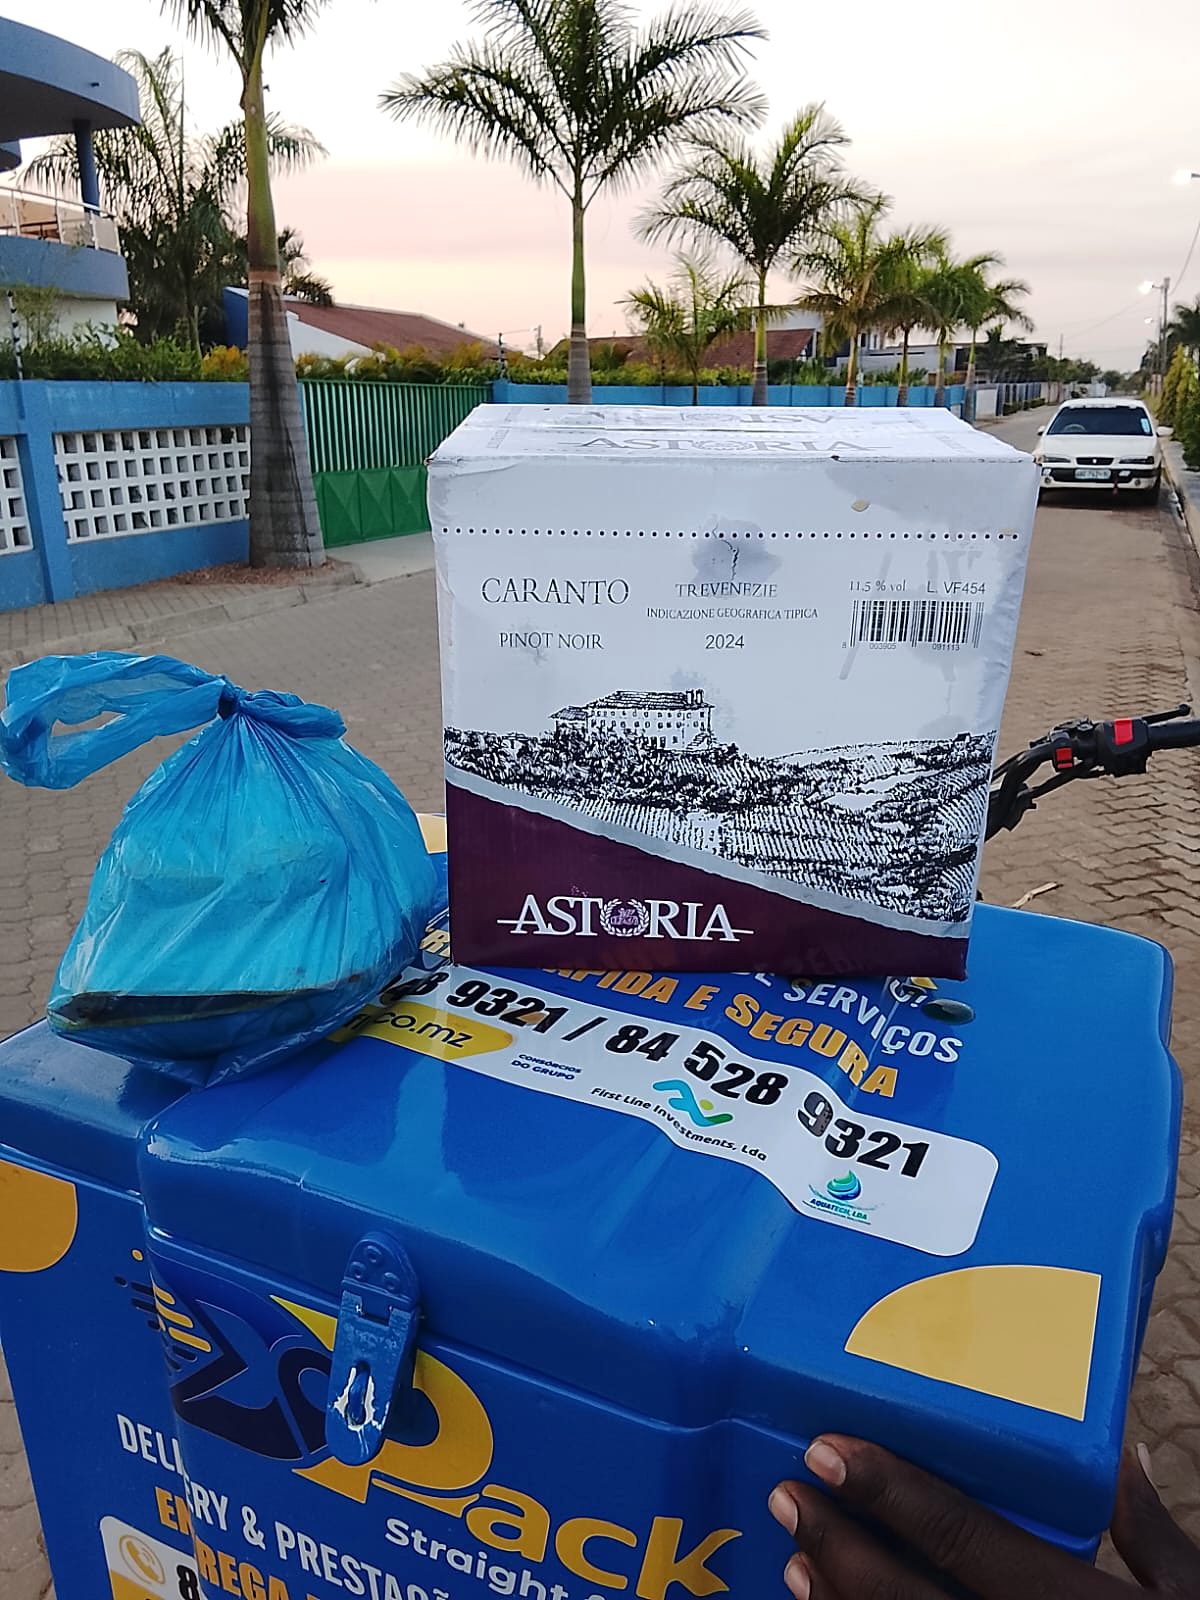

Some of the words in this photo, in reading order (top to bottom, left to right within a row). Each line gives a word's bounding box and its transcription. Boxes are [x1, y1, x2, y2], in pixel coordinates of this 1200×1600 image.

[559, 437, 893, 451] ASTORIA
[481, 577, 629, 605] CARANTO
[675, 582, 778, 598] TREVENEZIE
[891, 579, 906, 592] vol
[944, 581, 986, 594] VF454
[647, 607, 715, 620] INDICAZIONE
[717, 607, 781, 620] GEOGRAFICA
[784, 608, 818, 621] TIPICA
[499, 632, 553, 649] PINOT
[558, 633, 604, 650] NOIR
[705, 633, 745, 650] 2024
[497, 894, 754, 941] ASTORIA
[783, 978, 963, 1063] SERVIÇOS
[683, 985, 721, 1011] E
[724, 993, 899, 1098] SEGURA
[446, 980, 569, 1034] 9321
[605, 1024, 680, 1062] 84
[684, 1040, 789, 1106] 528
[797, 1091, 930, 1178] 9321
[511, 1060, 530, 1069] DO
[532, 1066, 575, 1080] GRUPO
[591, 1087, 622, 1101] First
[623, 1095, 652, 1109] Line
[653, 1104, 737, 1151] Investments,
[742, 1144, 768, 1161] Lda
[241, 1506, 267, 1550] &
